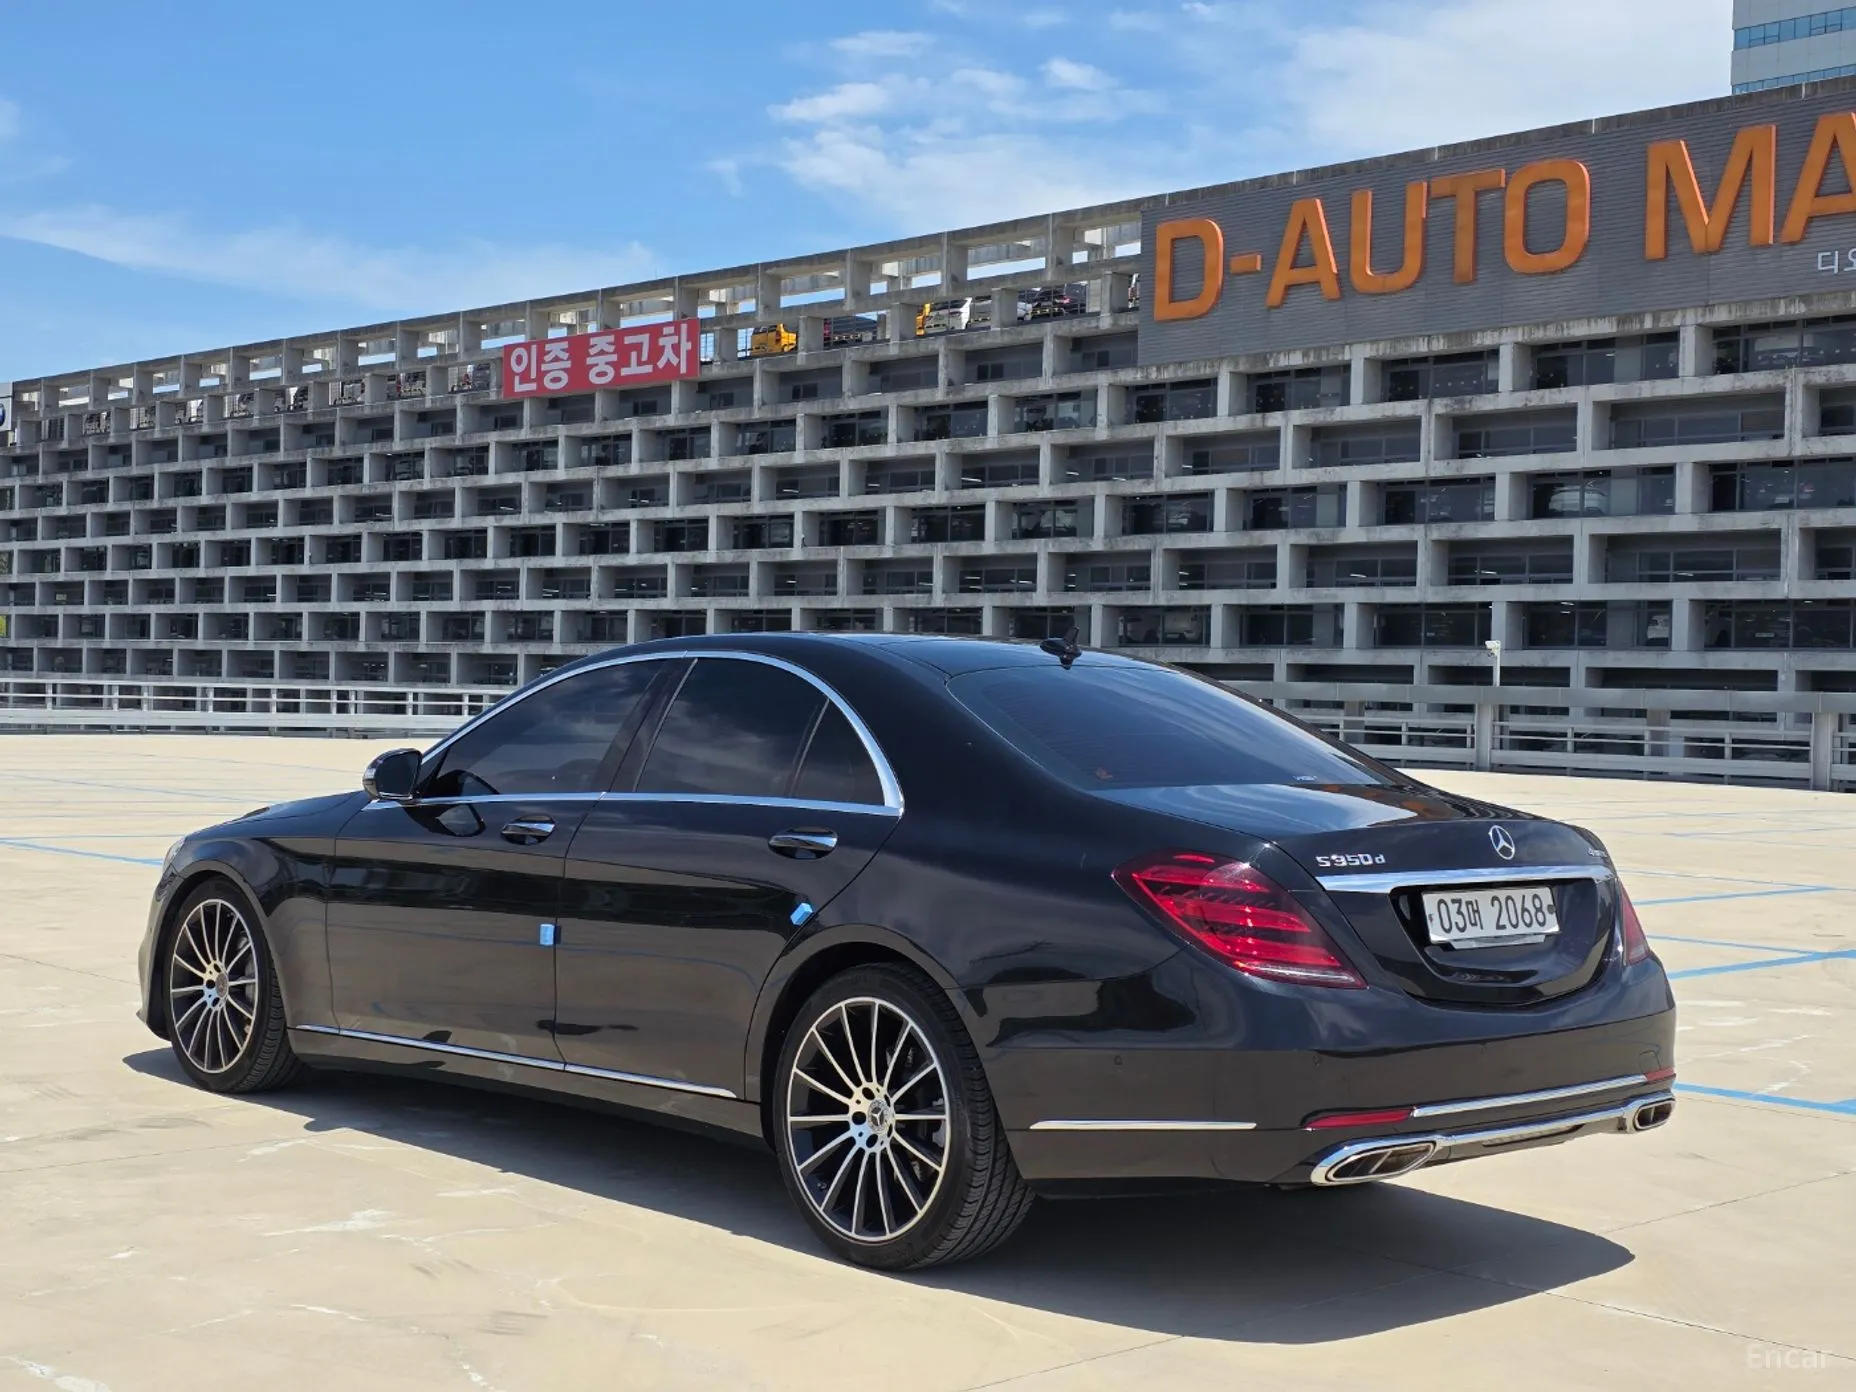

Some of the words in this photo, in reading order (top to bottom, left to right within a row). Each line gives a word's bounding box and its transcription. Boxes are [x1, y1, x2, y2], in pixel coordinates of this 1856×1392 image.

[1154, 158, 1591, 322] D-AUTO
[1645, 111, 1856, 260] MA
[510, 341, 572, 393] 인증
[586, 323, 692, 384] 중고차
[1437, 898, 1484, 934] 03머
[1491, 894, 1547, 930] 2068
